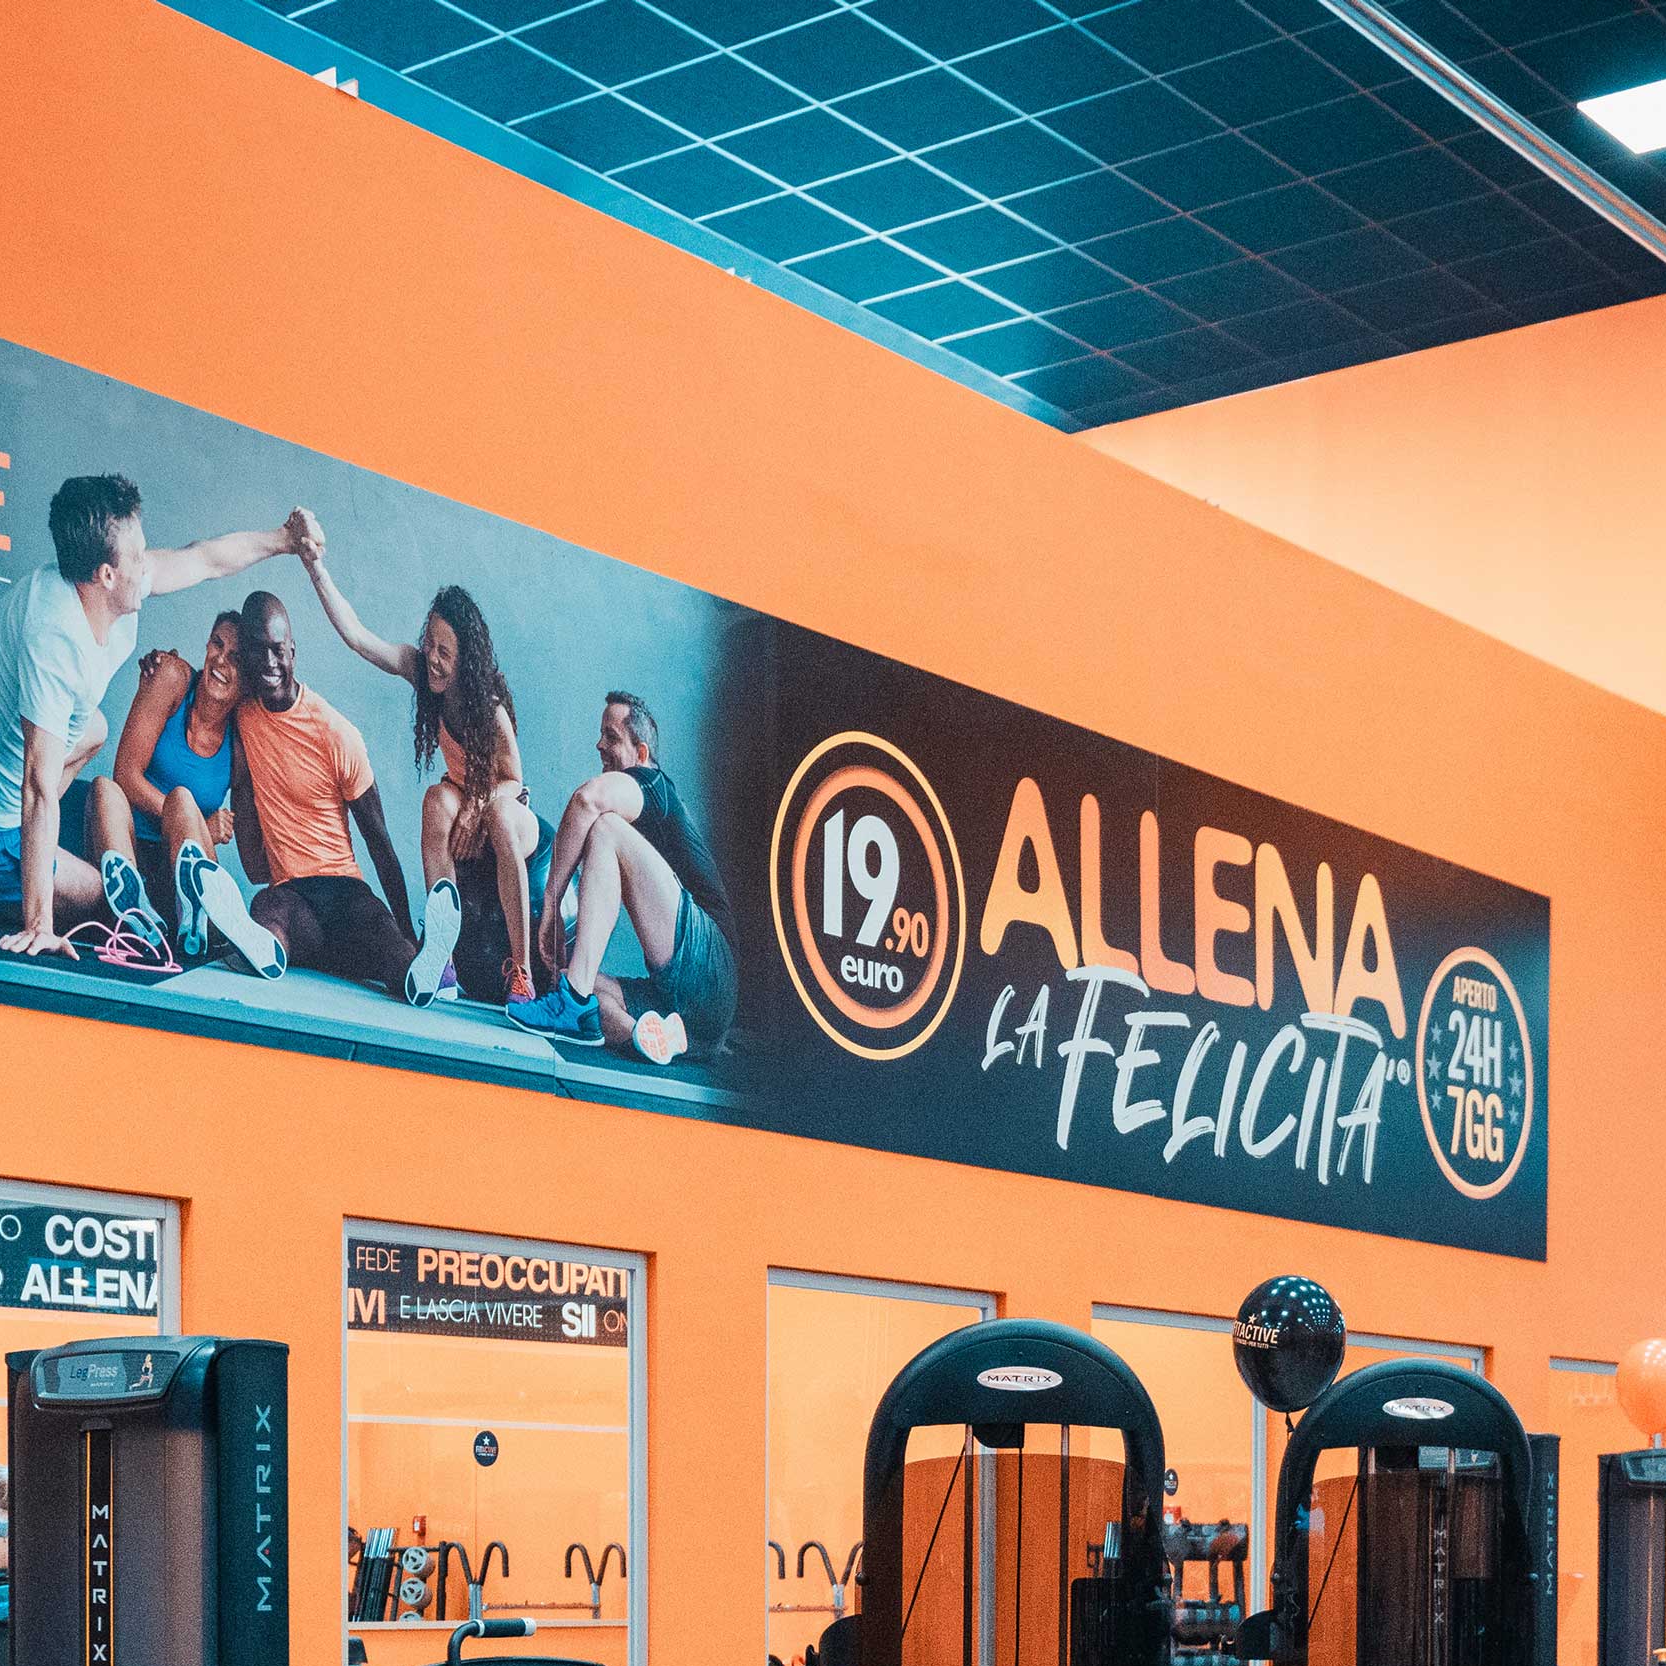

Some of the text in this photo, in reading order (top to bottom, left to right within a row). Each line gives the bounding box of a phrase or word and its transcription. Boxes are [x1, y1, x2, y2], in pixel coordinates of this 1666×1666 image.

[980, 776, 1407, 1040] ALLENA
[840, 953, 904, 993] euro
[1452, 975, 1497, 1012] APERTO
[981, 984, 1047, 1072] LA
[1447, 1009, 1502, 1089] 24H
[1447, 1085, 1504, 1163] 7GG
[45, 1214, 157, 1261] COST
[356, 1246, 627, 1298] FEDE PREOCCUPATI
[400, 1295, 411, 1319] E
[417, 1296, 480, 1324] LASCIA
[485, 1301, 543, 1328] VIVERE
[562, 1301, 596, 1338] SII
[986, 1374, 1054, 1384] MATRIX
[256, 1403, 273, 1612] MATRIX
[91, 1503, 110, 1662] MATRIX
[1433, 1528, 1447, 1624] MATRIX
